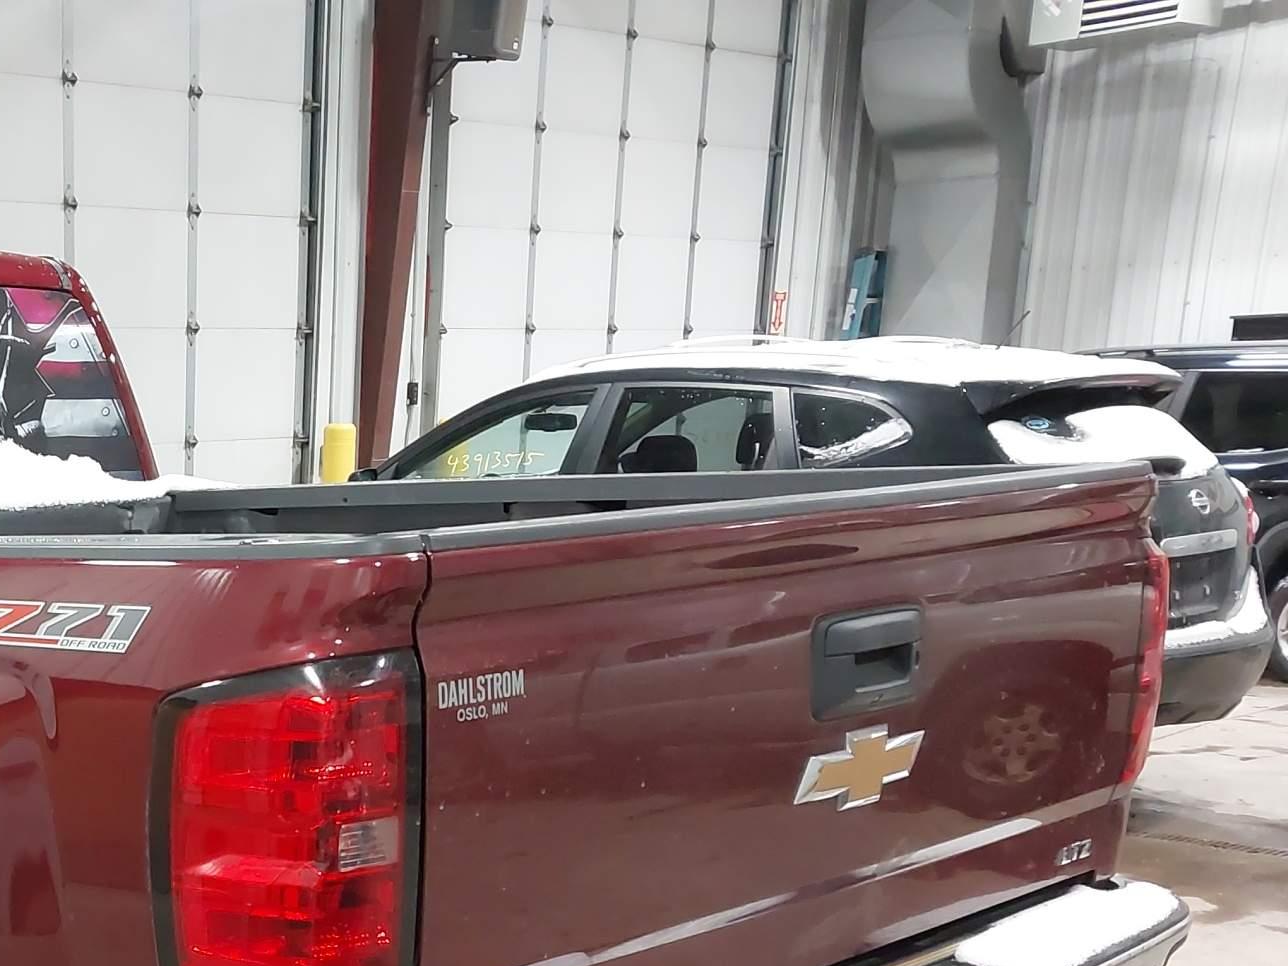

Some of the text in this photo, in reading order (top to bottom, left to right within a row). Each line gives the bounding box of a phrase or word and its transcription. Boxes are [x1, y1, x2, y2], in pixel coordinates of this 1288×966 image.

[61, 638, 126, 651] OFF ROAD
[457, 701, 509, 721] OSLO, MN
